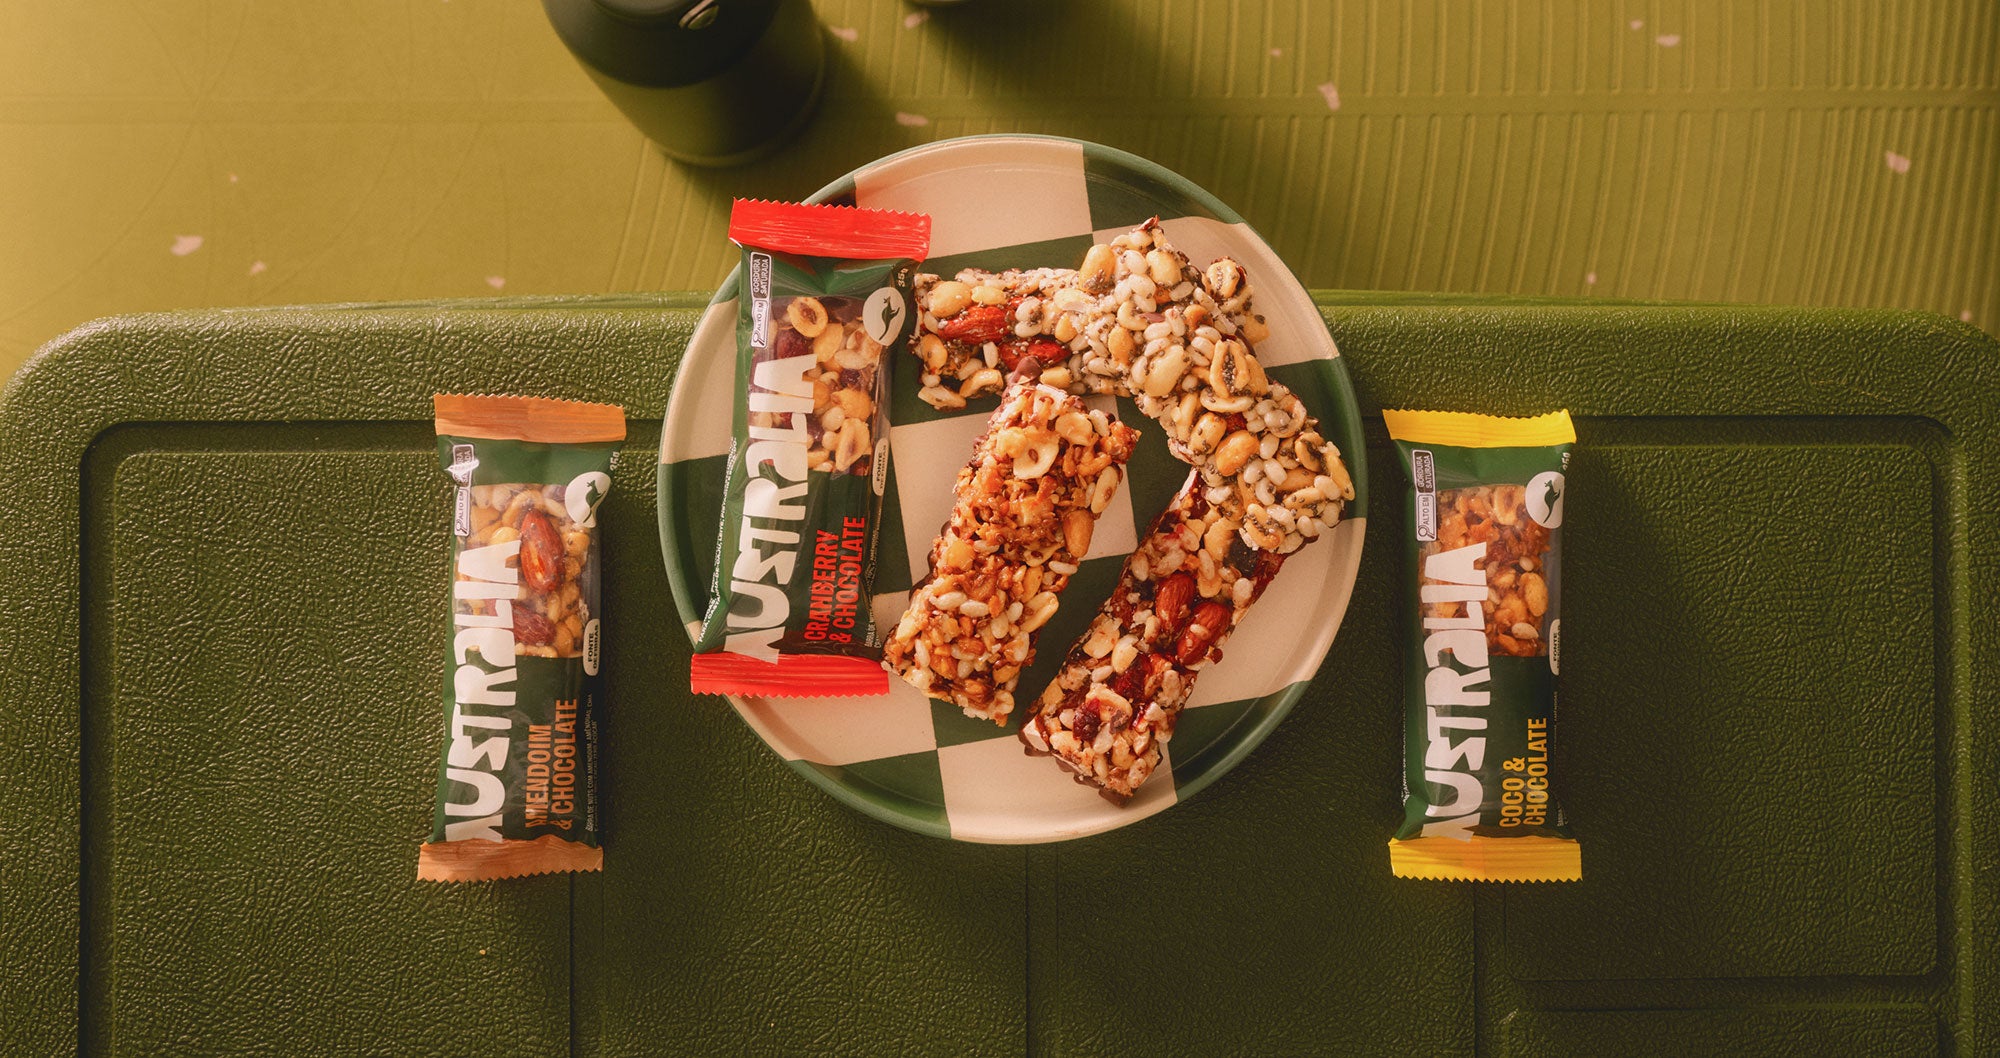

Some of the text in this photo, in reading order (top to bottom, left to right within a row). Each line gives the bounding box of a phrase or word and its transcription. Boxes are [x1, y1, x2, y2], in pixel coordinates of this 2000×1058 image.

[752, 258, 761, 293] GORDURA
[760, 258, 769, 295] SATURADA
[723, 354, 817, 665] AUSTRALIA
[1416, 456, 1425, 488] GORDURA
[1422, 508, 1430, 525] ALTO
[1424, 455, 1433, 488] SATURADA
[804, 530, 839, 640] CRANBERRY
[829, 516, 865, 643] & CHOCOLATE
[445, 540, 521, 842] AUSTRALIA
[1420, 541, 1490, 842] AUSTRALIA
[525, 724, 552, 828] AMENDOIM
[550, 698, 577, 830] & CHOCOLATE
[1499, 757, 1526, 827] COCO &
[1523, 718, 1549, 825] CHOCOLATE
